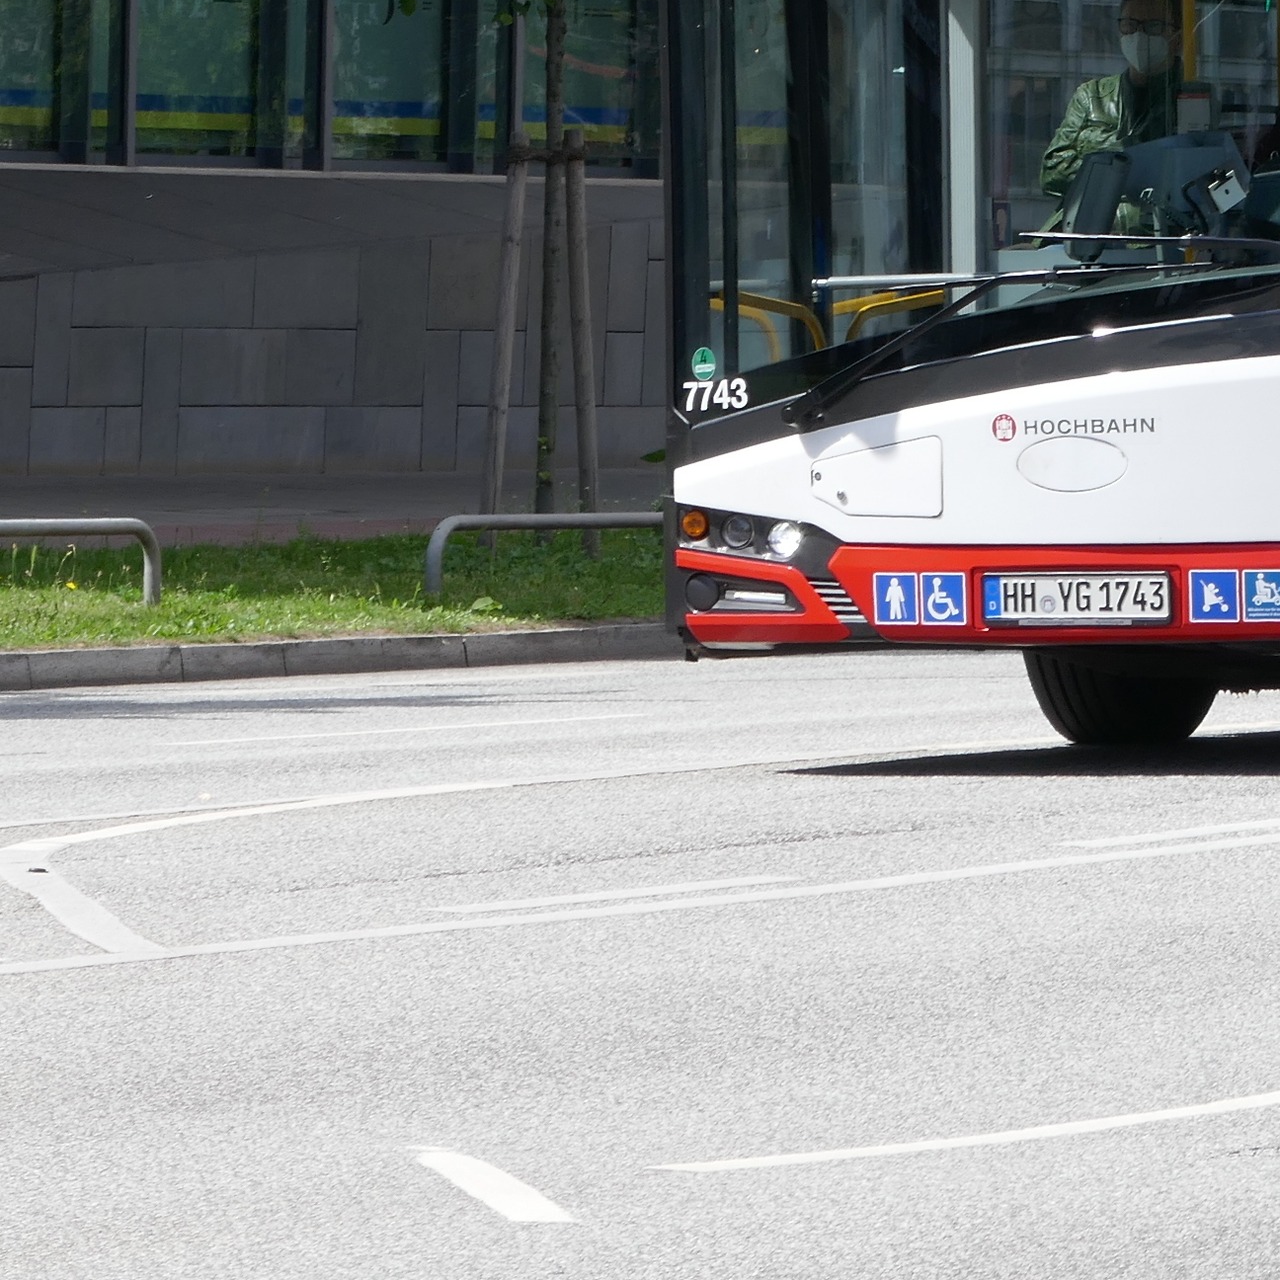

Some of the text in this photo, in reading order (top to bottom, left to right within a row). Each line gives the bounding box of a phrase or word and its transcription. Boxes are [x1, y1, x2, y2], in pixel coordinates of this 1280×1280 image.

[700, 349, 707, 364] 4
[682, 377, 749, 412] 7743
[1023, 416, 1156, 436] HOCHBAHN
[988, 601, 997, 611] D
[1002, 580, 1165, 613] HH YG 1743
